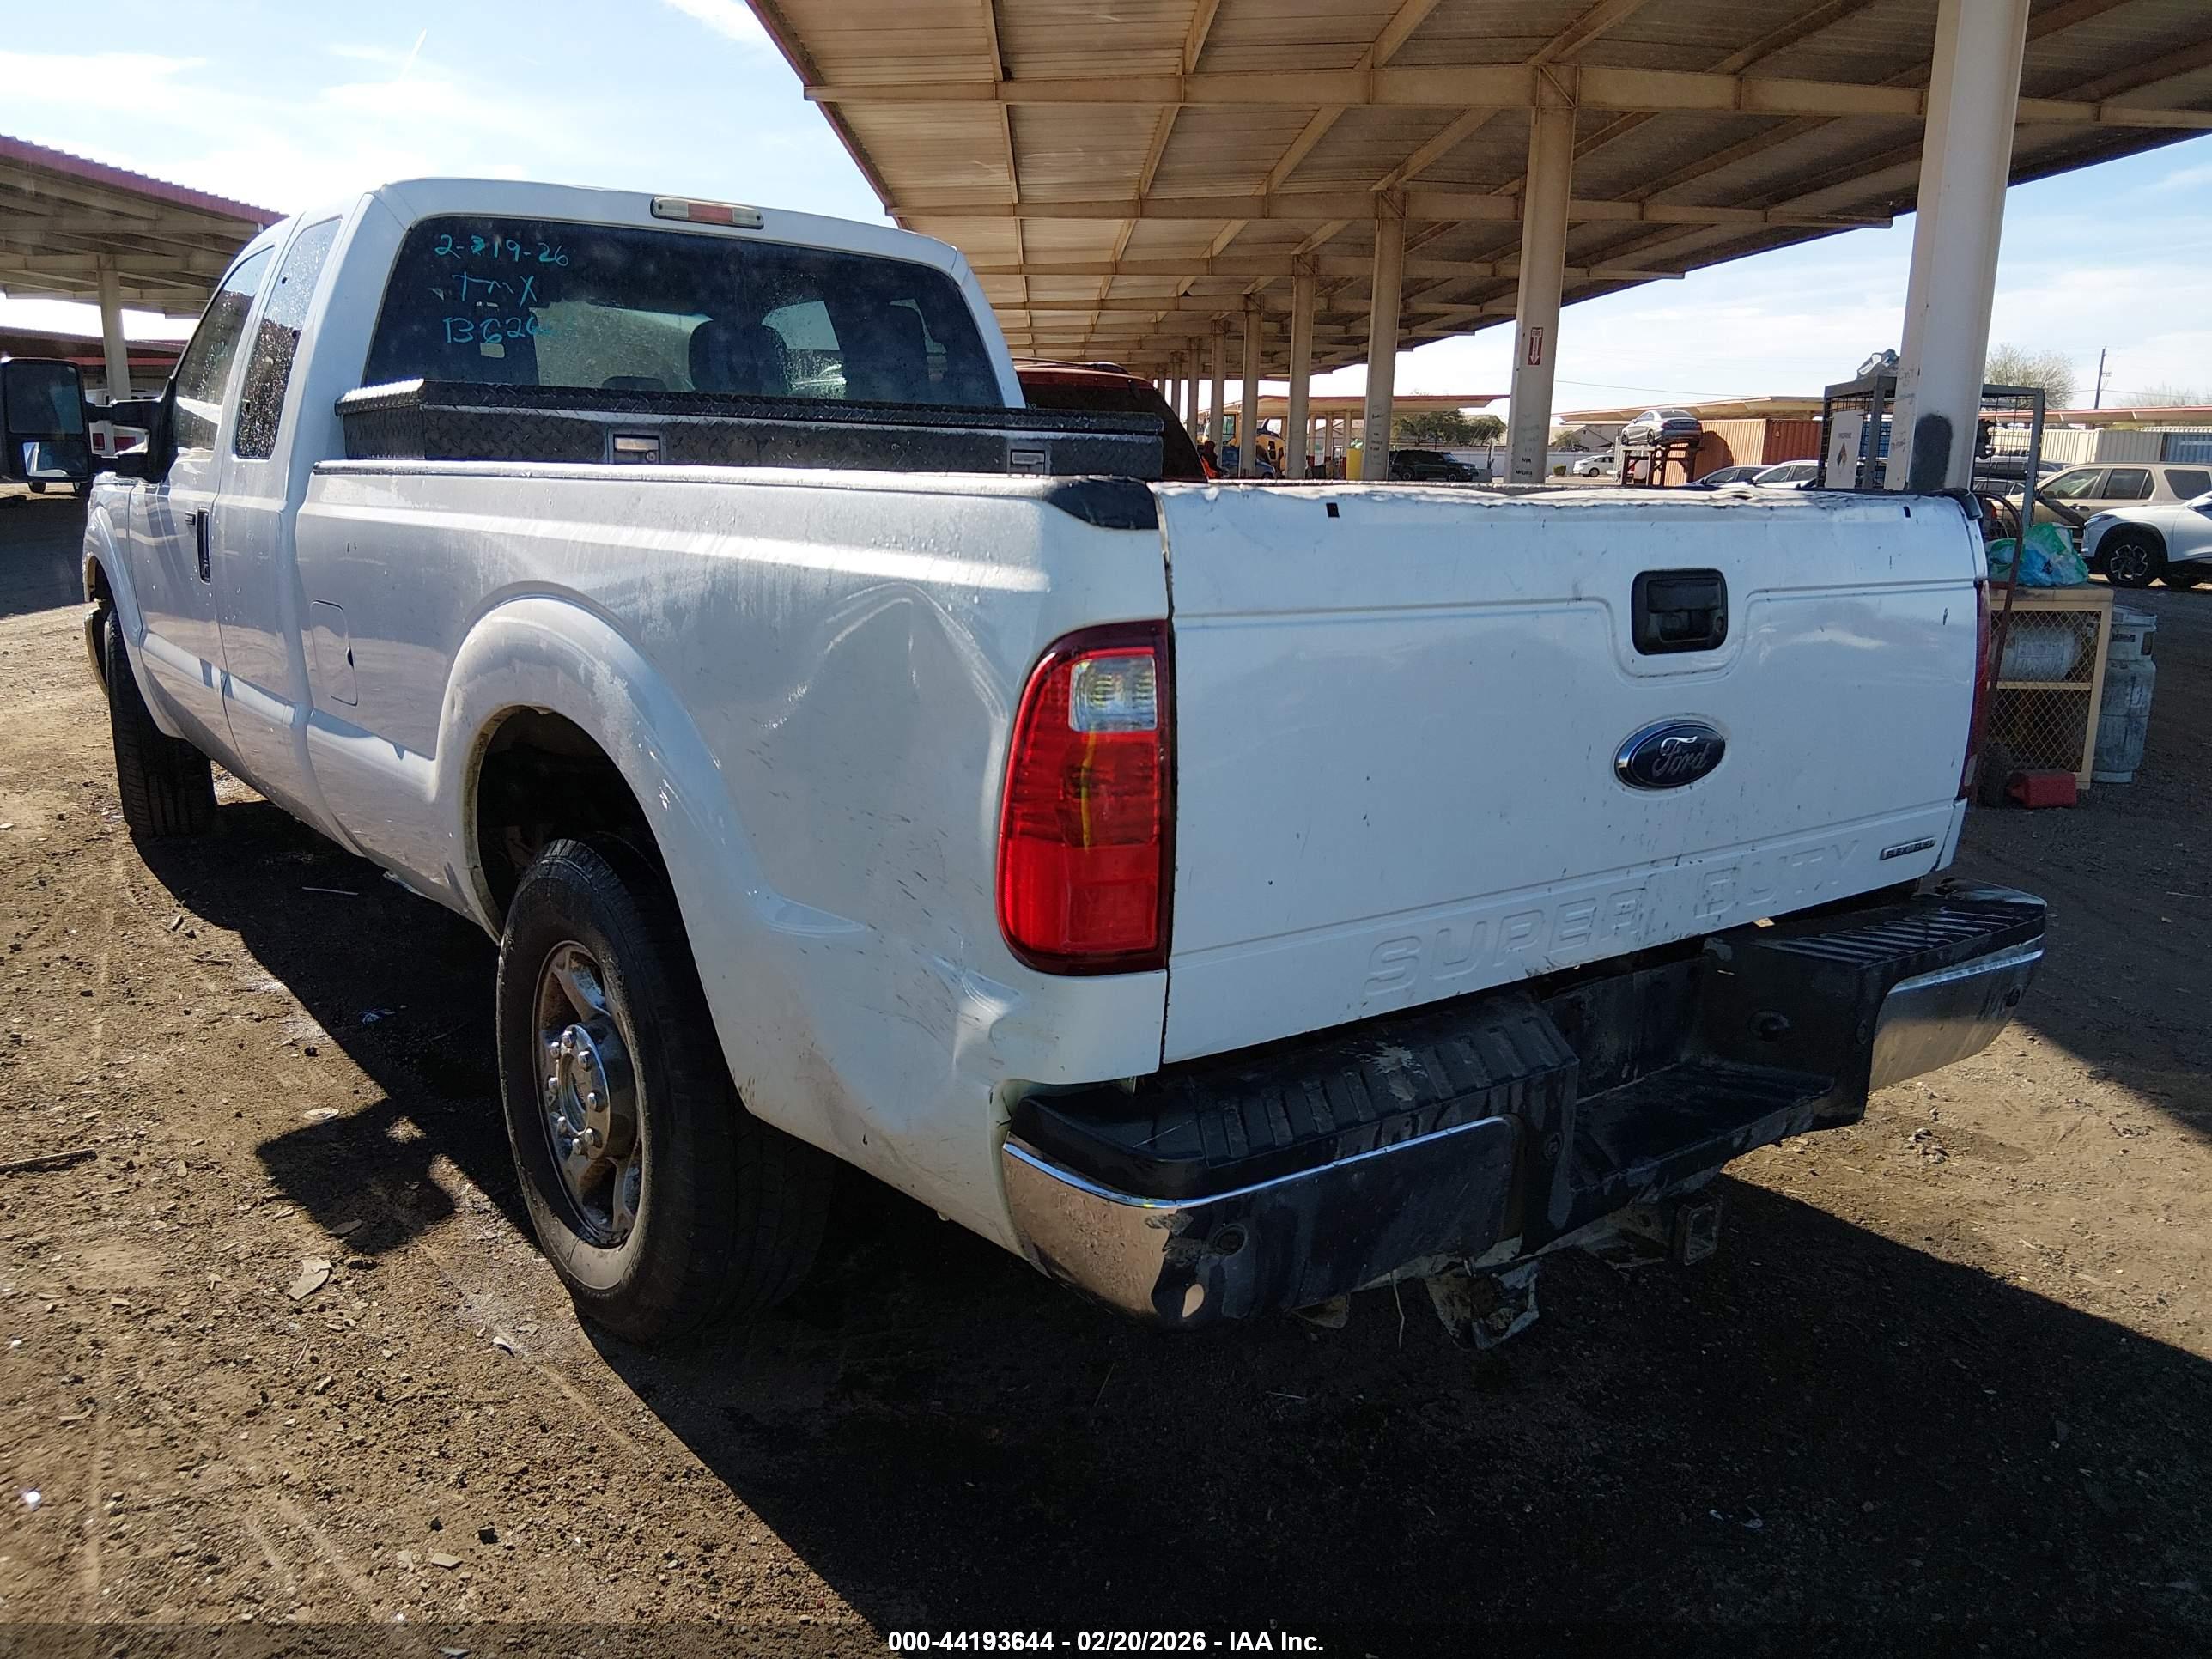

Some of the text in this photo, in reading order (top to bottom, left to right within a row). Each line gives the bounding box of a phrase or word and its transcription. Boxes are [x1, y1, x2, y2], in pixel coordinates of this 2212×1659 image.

[1651, 736, 1711, 777] Ford
[1364, 840, 1860, 996] SUPER DUTY
